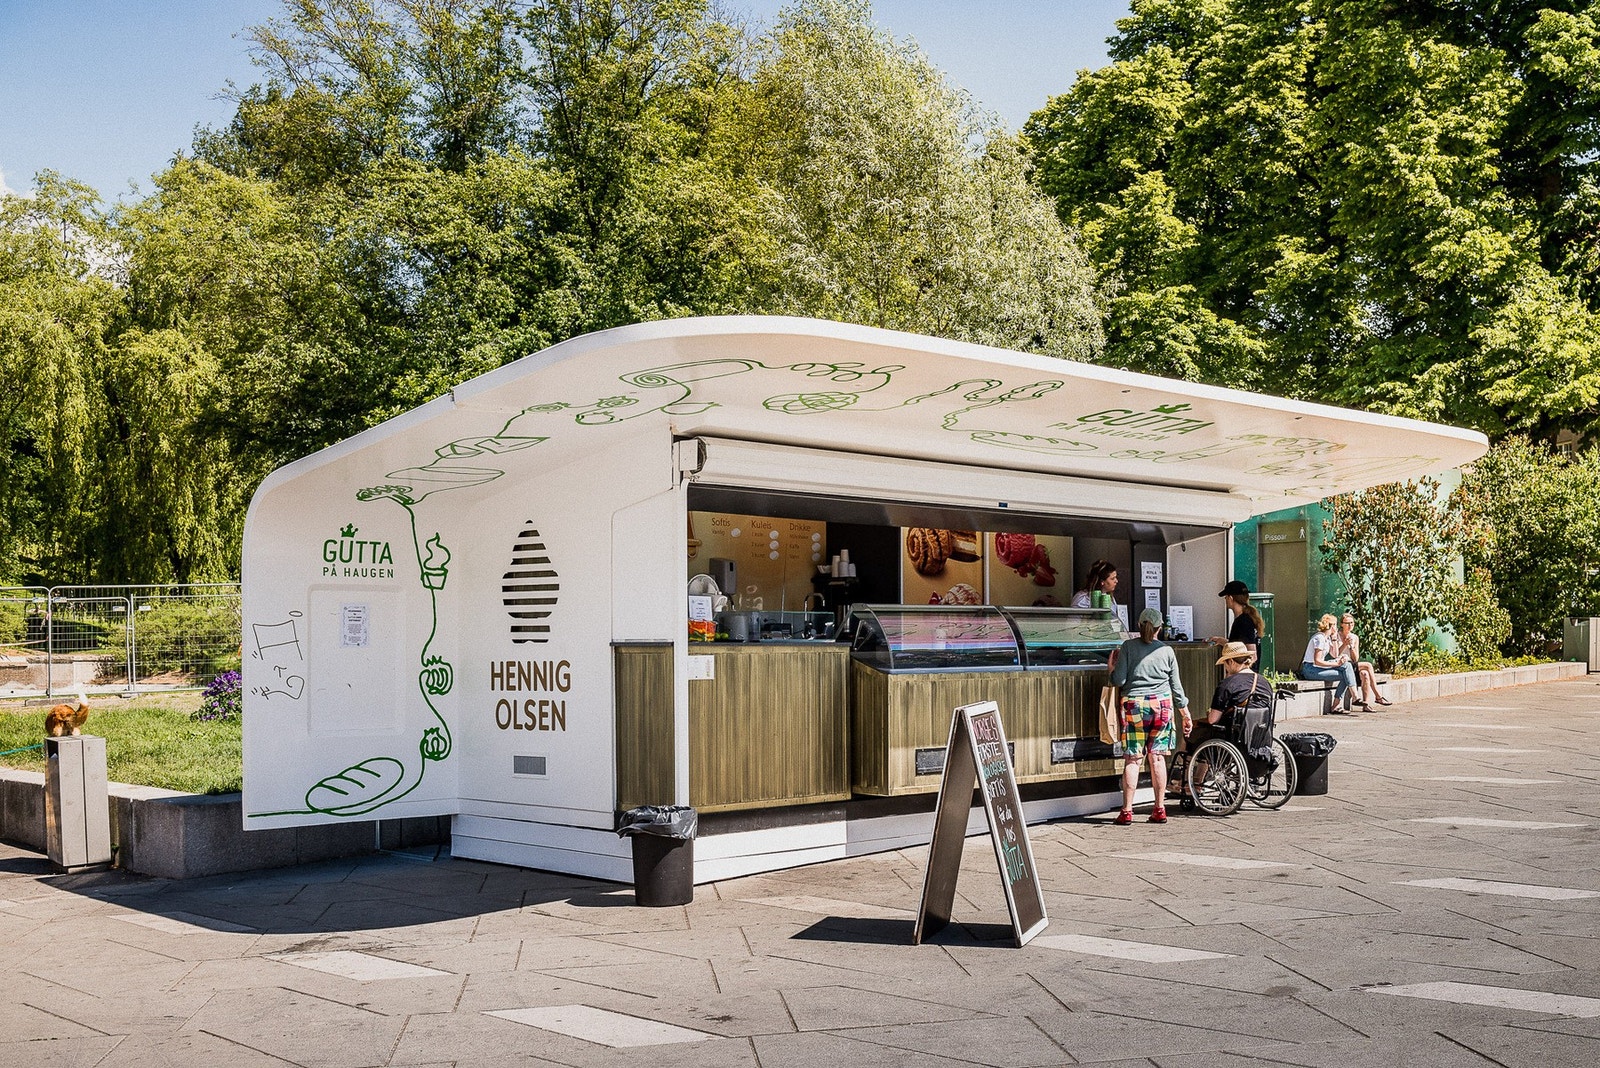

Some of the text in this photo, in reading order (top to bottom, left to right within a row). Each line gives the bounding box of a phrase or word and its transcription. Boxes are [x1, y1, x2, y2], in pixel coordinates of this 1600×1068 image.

[1047, 421, 1170, 442] PÅ HAUGEN
[1076, 408, 1215, 435] GUTTA
[1264, 533, 1287, 541] Pissoar
[323, 539, 393, 565] GUTTA
[323, 564, 394, 579] PÅ HAUGEN
[490, 659, 572, 693] HENNIG
[495, 698, 567, 732] OLSEN
